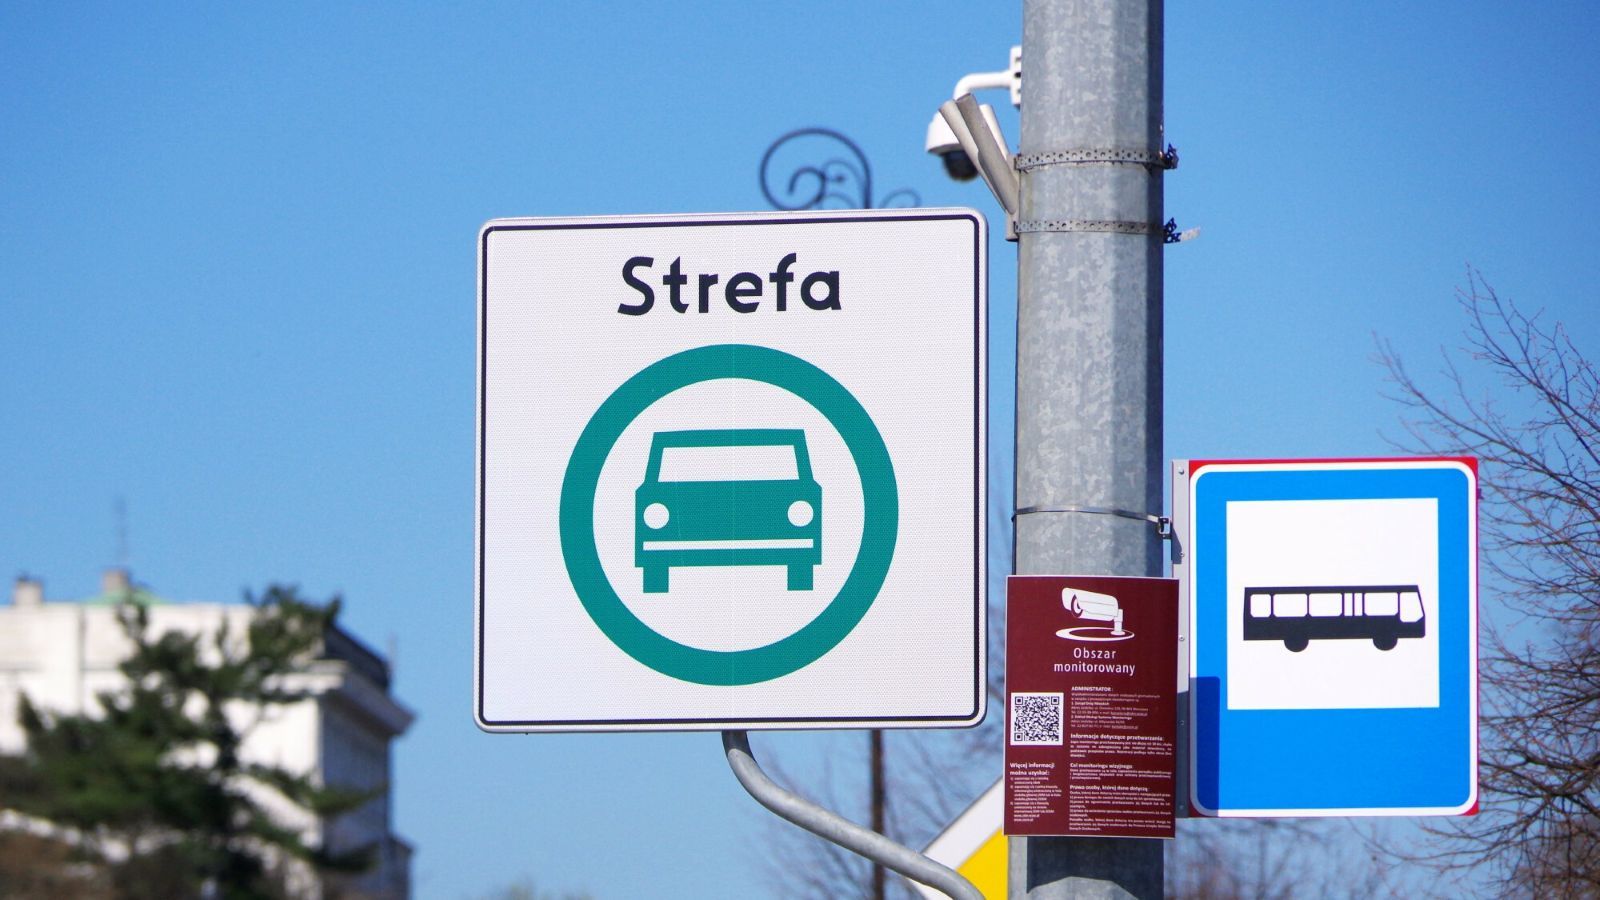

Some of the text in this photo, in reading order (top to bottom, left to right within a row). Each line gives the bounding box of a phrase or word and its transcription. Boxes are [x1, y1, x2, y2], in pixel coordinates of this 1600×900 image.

[617, 252, 842, 316] Strefa
[1073, 647, 1117, 659] Obszar
[1053, 661, 1136, 676] monitorowany
